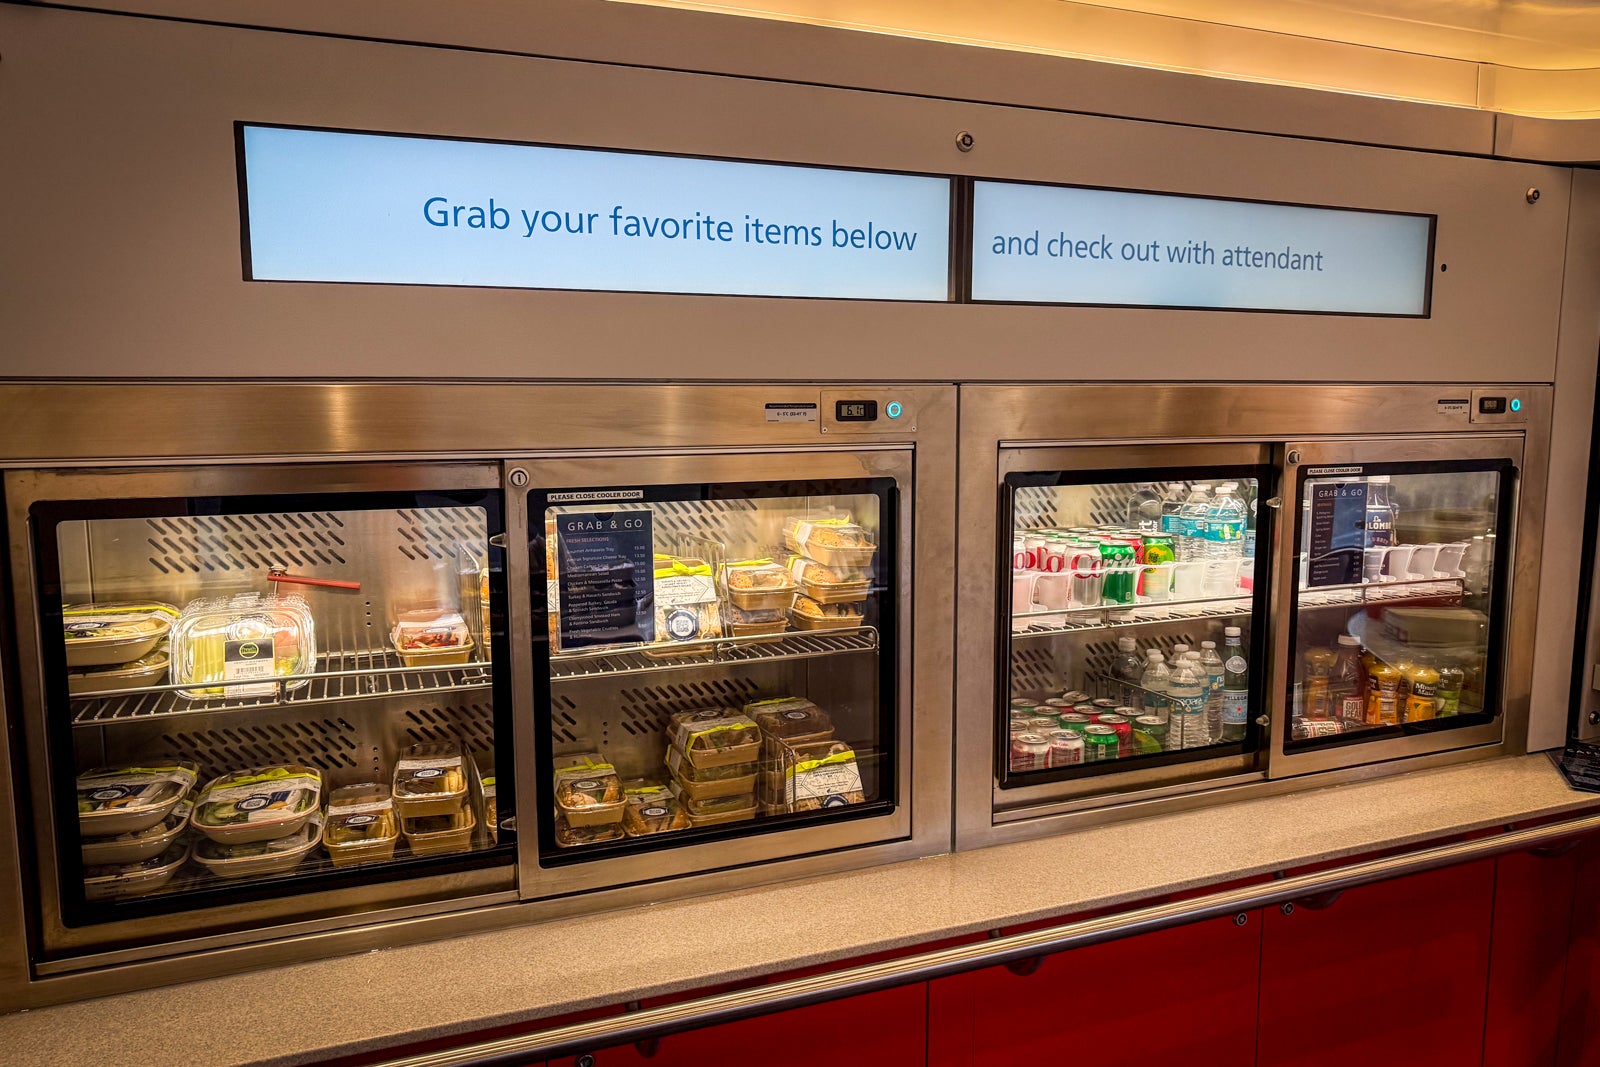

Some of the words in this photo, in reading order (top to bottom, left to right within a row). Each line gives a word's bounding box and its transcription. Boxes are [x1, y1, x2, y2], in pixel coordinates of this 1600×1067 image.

[423, 196, 511, 230] Grab
[521, 209, 599, 239] your
[609, 205, 734, 243] favorite
[744, 214, 823, 247] items
[831, 219, 918, 251] below
[991, 229, 1039, 257] and
[1046, 231, 1114, 260] check
[1120, 240, 1160, 263] out
[1166, 239, 1215, 265] with
[1221, 245, 1324, 272] attendant
[1318, 489, 1338, 498] GRAB
[1341, 489, 1347, 497] &
[1350, 488, 1363, 497] GO
[567, 521, 603, 531] GRAB
[610, 520, 618, 529] &
[624, 519, 643, 528] GO
